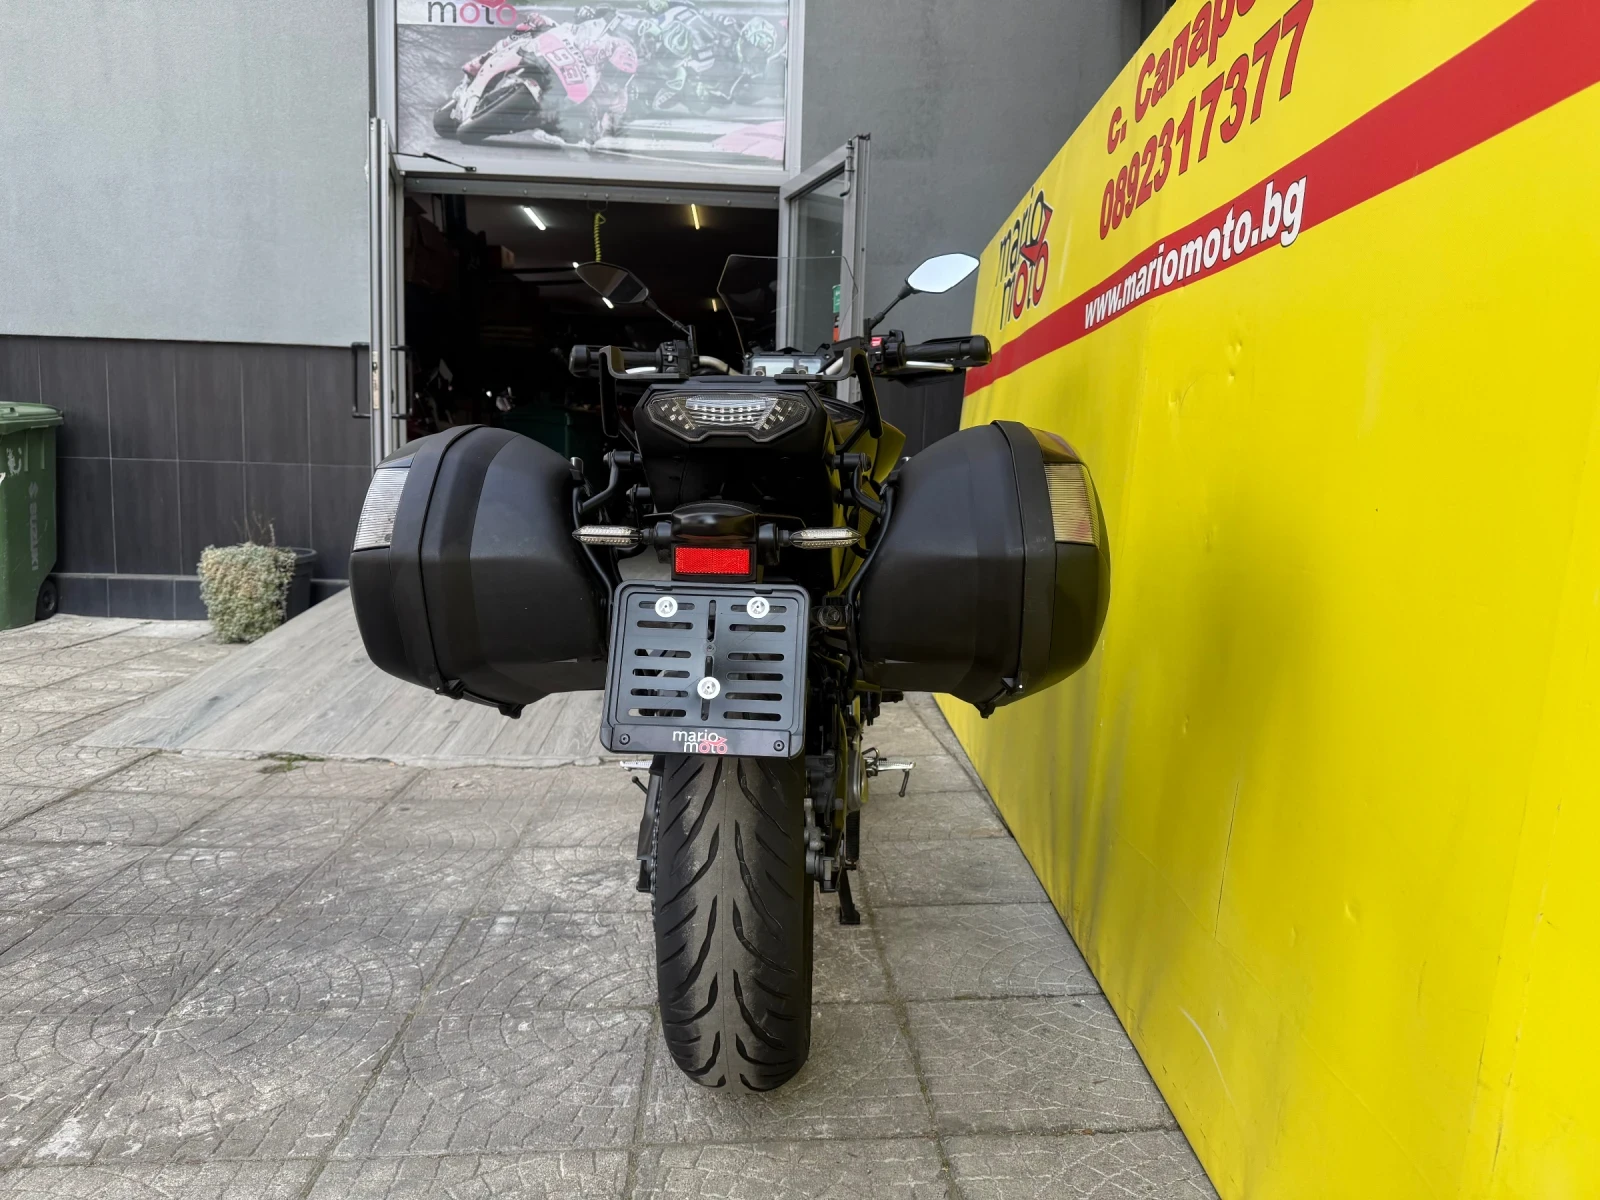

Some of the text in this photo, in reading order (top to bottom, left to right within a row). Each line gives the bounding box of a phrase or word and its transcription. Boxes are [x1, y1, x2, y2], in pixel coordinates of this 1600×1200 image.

[427, 1, 517, 26] moto
[1100, 0, 1314, 240] 0892317377
[995, 187, 1045, 287] mario
[1084, 175, 1307, 329] www.mariomoto.bg
[1000, 240, 1049, 330] moto
[672, 729, 719, 742] mario
[683, 741, 728, 754] moto
